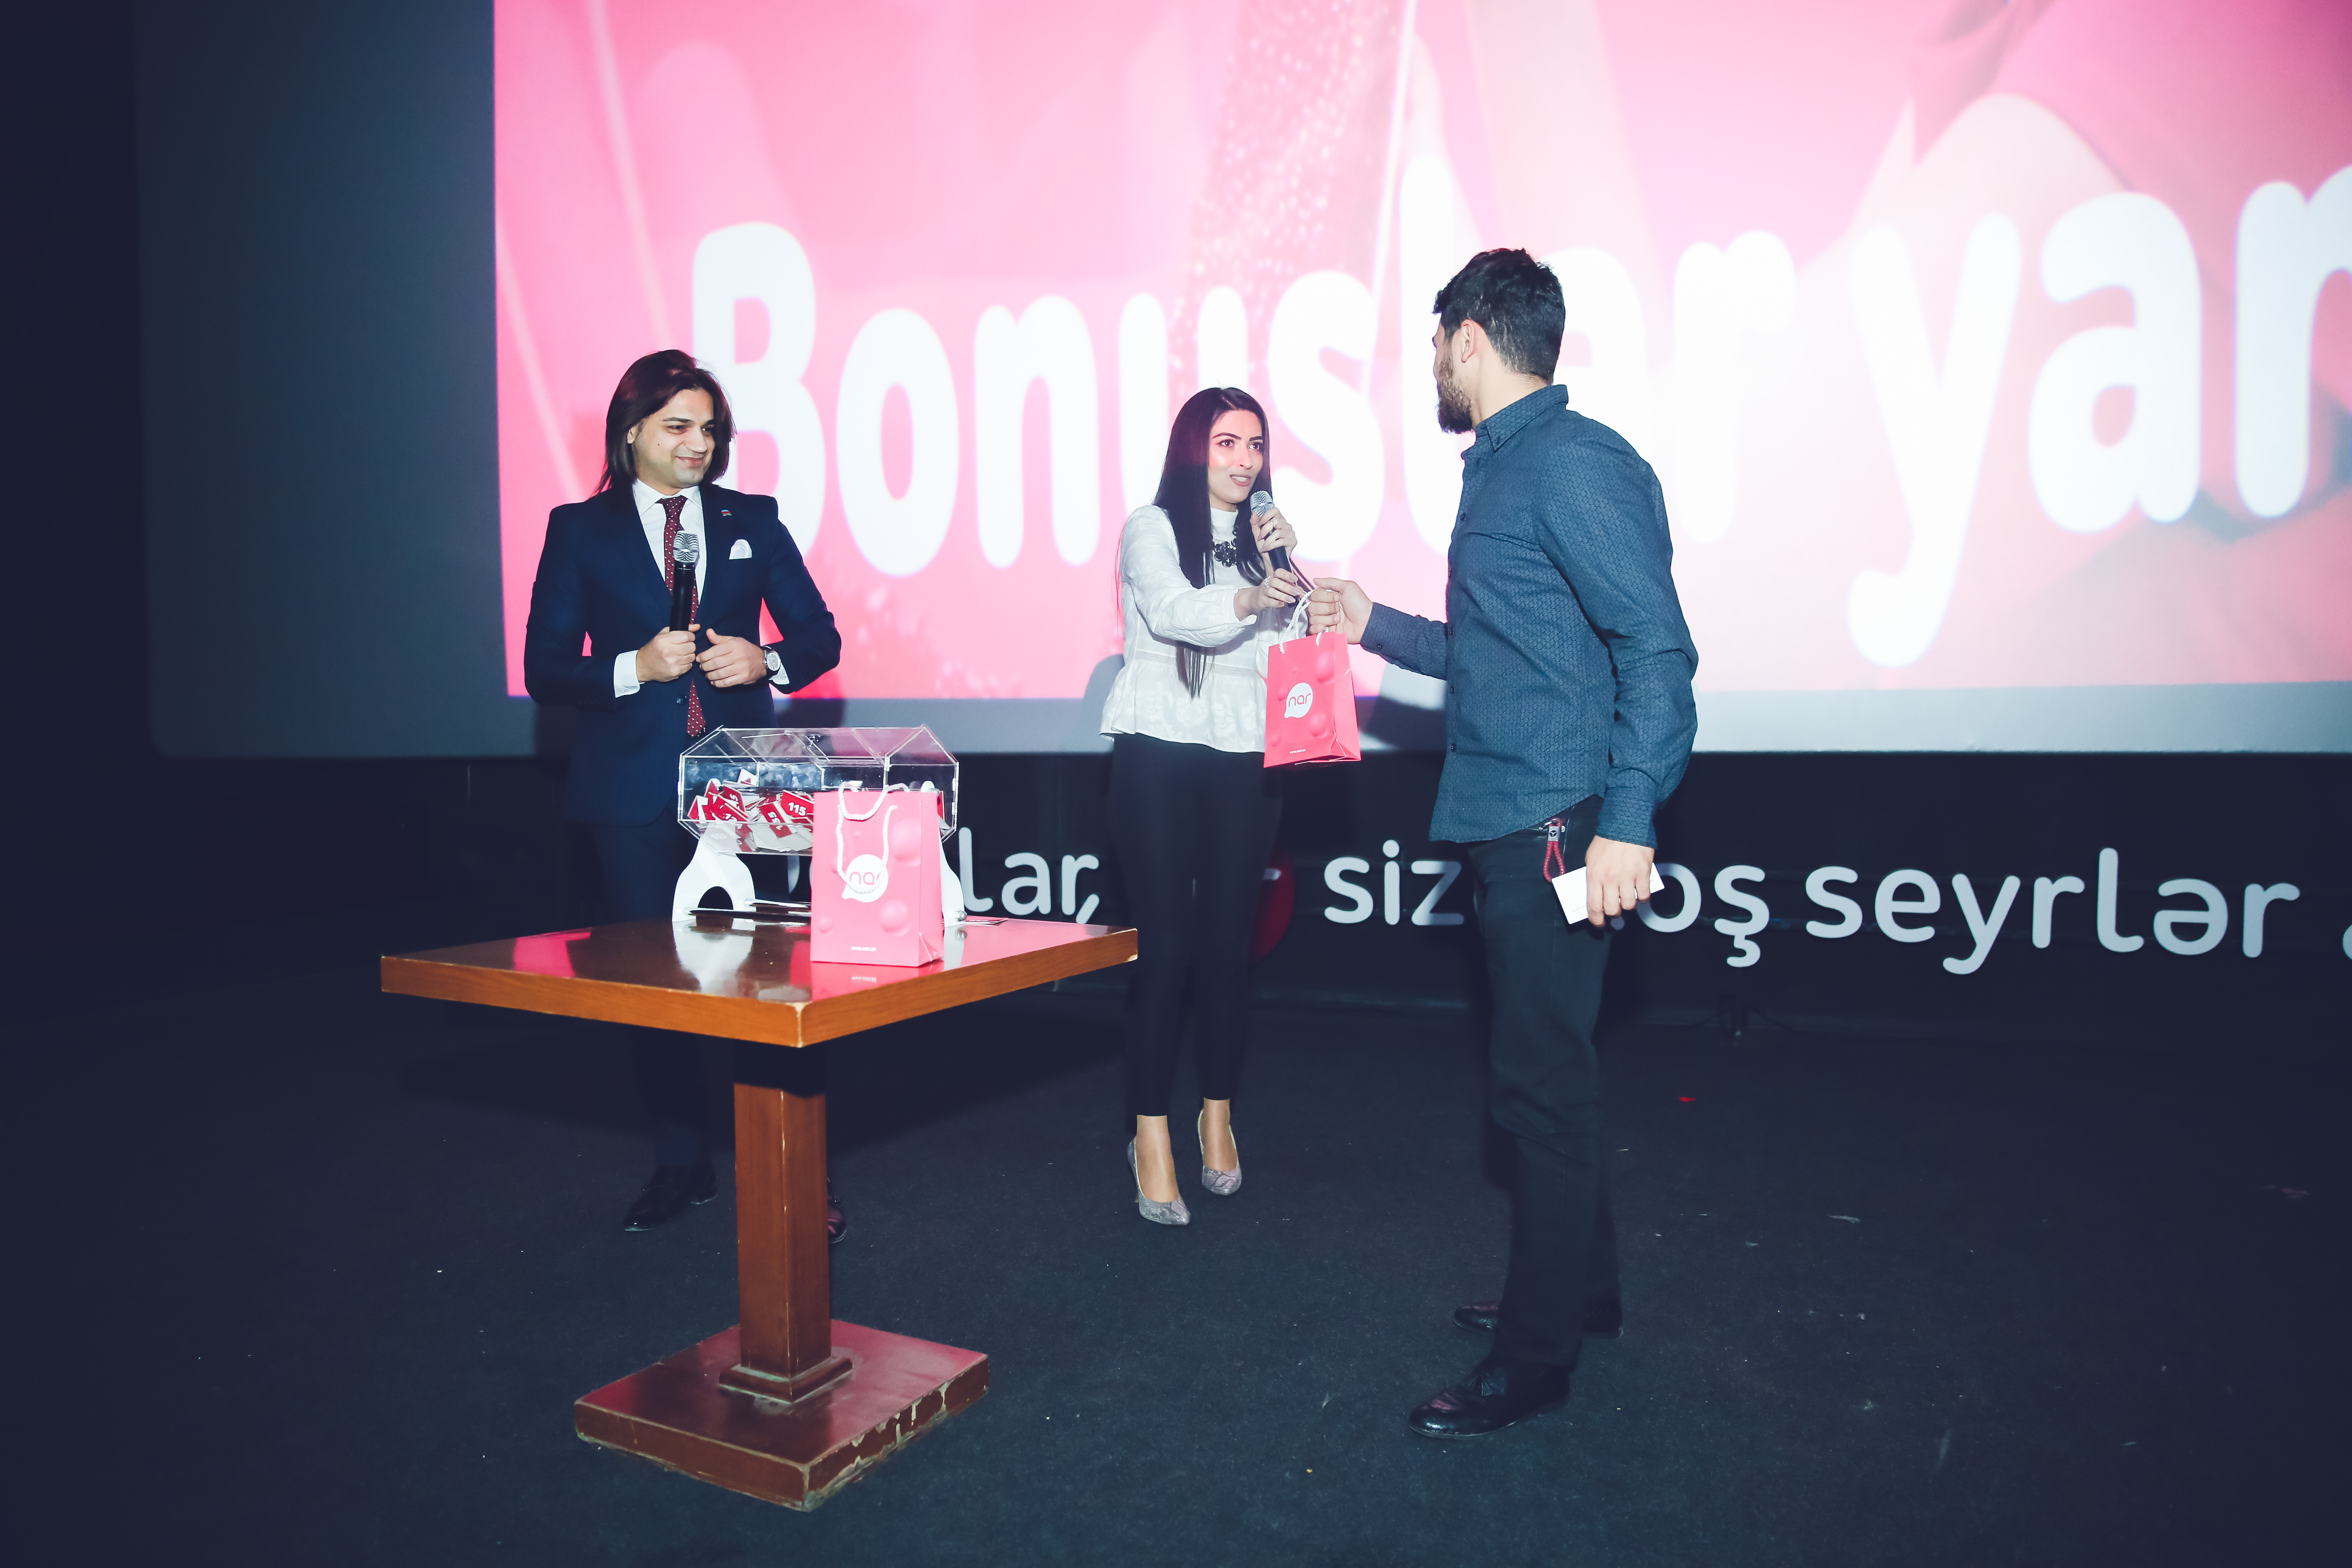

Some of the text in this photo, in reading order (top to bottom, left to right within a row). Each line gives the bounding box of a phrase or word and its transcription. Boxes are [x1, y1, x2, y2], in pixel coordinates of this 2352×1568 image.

[1288, 693, 1311, 707] nar
[788, 802, 807, 816] 115
[1324, 840, 1465, 926] siz
[1610, 862, 1770, 968] oş
[1805, 847, 2301, 975] seyrlər
